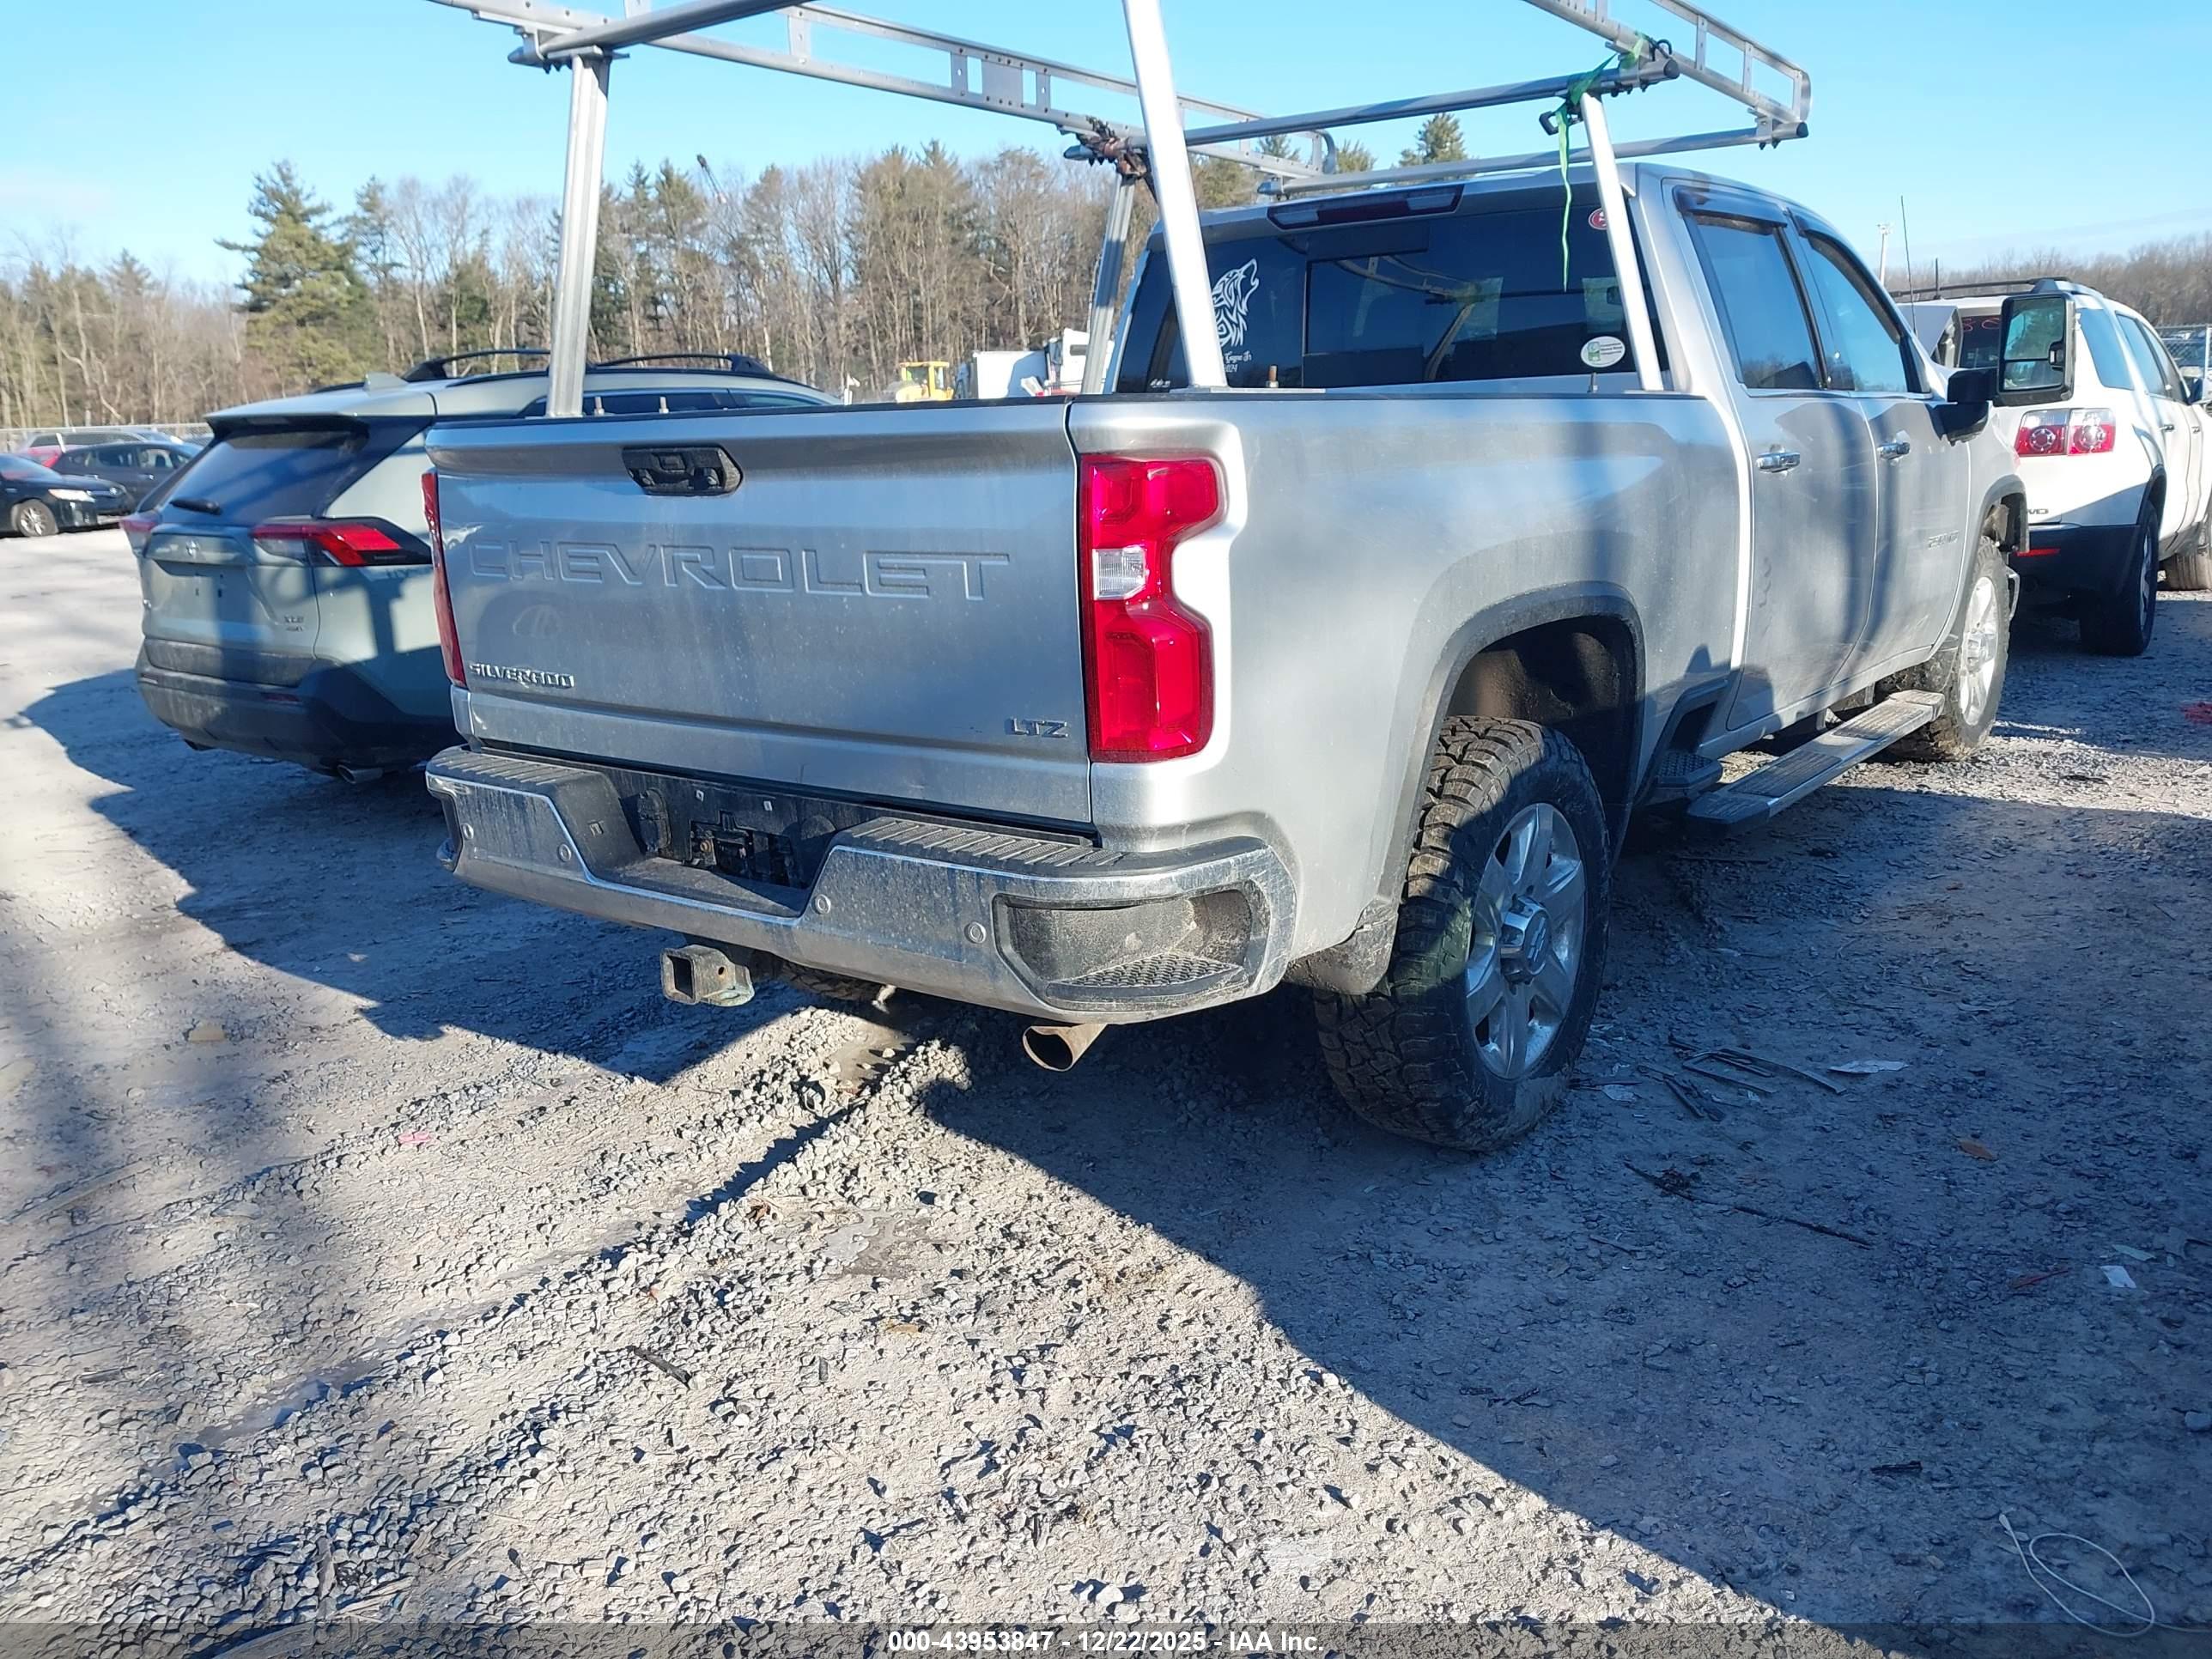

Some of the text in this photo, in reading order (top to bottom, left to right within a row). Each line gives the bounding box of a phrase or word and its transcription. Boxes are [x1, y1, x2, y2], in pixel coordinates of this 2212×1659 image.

[469, 539, 1011, 601] CHEVROLET
[469, 662, 575, 689] SILVERADO
[1004, 717, 1069, 738] LTZ
